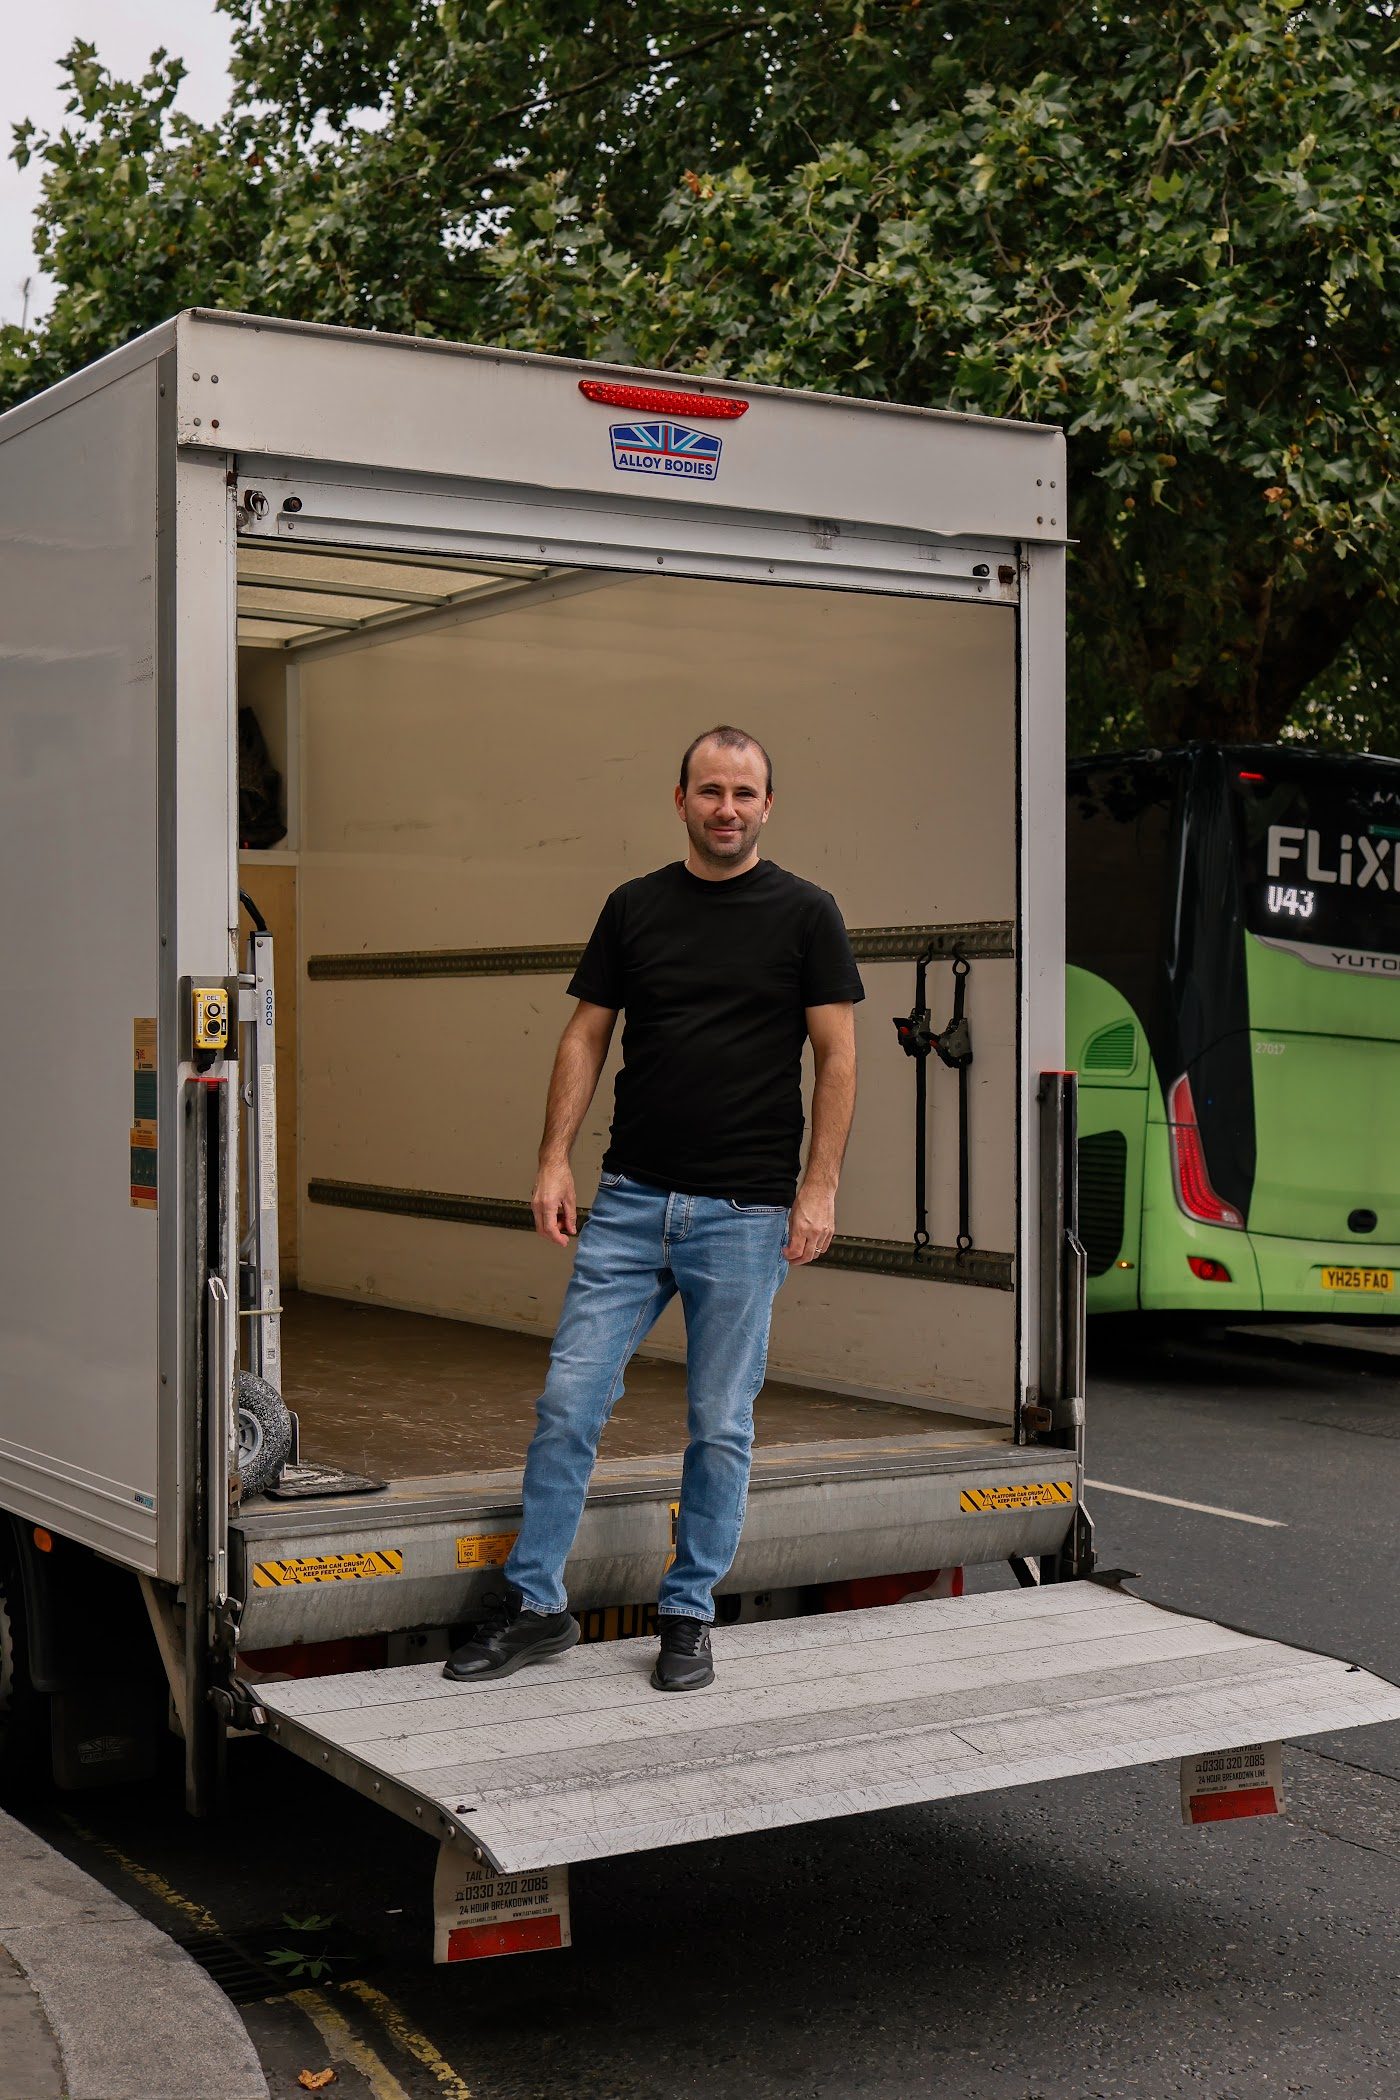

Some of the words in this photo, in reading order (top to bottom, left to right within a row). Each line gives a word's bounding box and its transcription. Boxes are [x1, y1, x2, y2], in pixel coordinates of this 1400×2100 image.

[619, 453, 661, 469] ALLOY
[664, 458, 713, 475] BODIES
[1267, 825, 1400, 892] FLiX
[1267, 885, 1314, 918] U43
[1331, 952, 1400, 971] YUTO
[1328, 1270, 1360, 1287] YH25
[295, 1563, 328, 1572] PLATFORM
[343, 1560, 365, 1568] CRUSH
[320, 1568, 336, 1576] FEET
[336, 1567, 357, 1575] CLEAR
[1202, 1758, 1224, 1772] 0330
[1226, 1757, 1242, 1770] 320
[1244, 1754, 1265, 1767] 2085
[1206, 1774, 1221, 1783] HOUR
[1222, 1771, 1253, 1782] BREAKDOWN
[1254, 1769, 1265, 1778] LINE
[466, 1869, 483, 1882] TAIL
[465, 1883, 493, 1900] 0330
[497, 1880, 518, 1896] 320
[520, 1876, 548, 1893] 2085
[460, 1905, 469, 1915] 24
[470, 1902, 489, 1914] HOUR
[491, 1896, 533, 1911] BREAKDOWN
[534, 1894, 550, 1905] LINE
